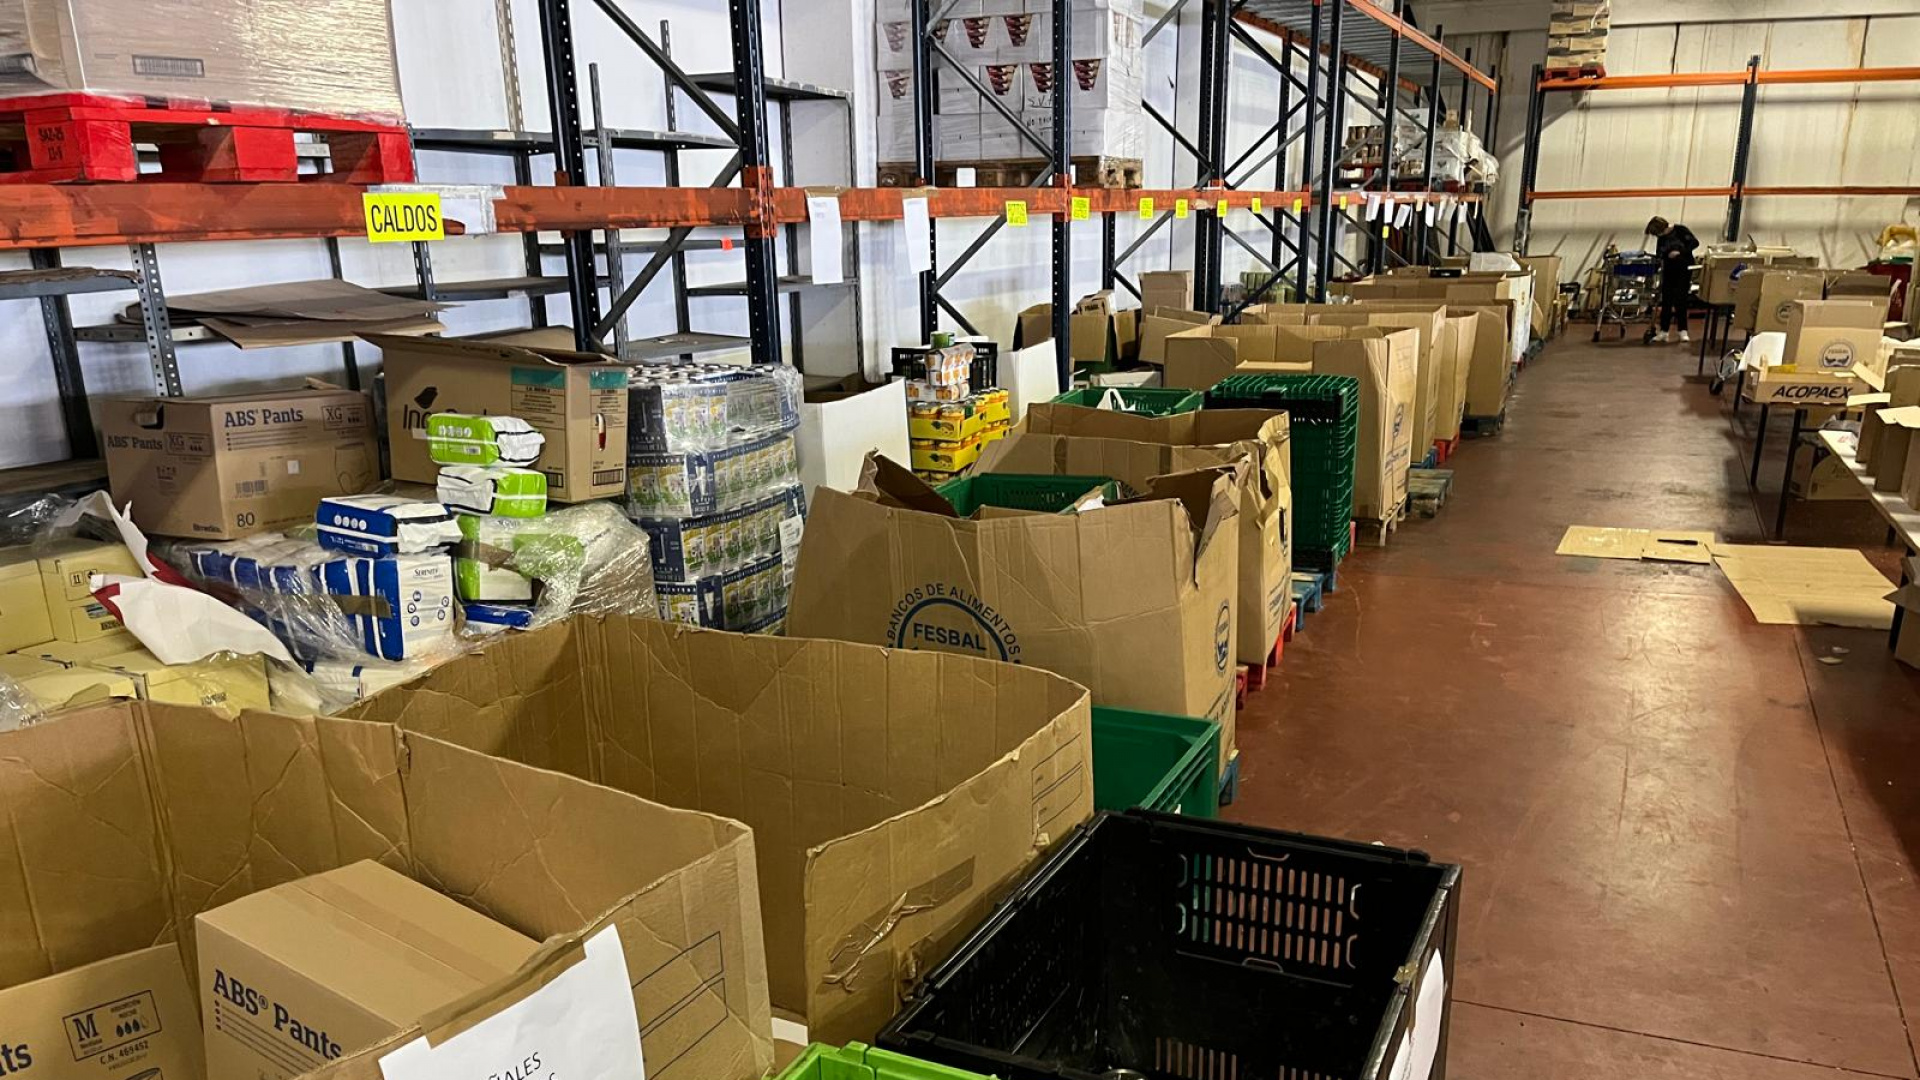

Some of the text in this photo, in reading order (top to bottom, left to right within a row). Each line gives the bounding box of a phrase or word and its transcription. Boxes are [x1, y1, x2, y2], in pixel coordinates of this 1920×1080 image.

[371, 204, 438, 233] CALDOS
[1771, 385, 1853, 399] ACOPAEX
[263, 407, 304, 425] Pants
[326, 407, 343, 421] XG
[132, 437, 163, 451] Pants
[236, 512, 256, 528] 80
[886, 582, 1022, 656] BANCOS DE ALIMENTOS
[913, 622, 987, 651] FESBAL
[72, 1013, 99, 1042] M
[273, 1002, 342, 1061] Pants
[0, 1043, 33, 1077] ts
